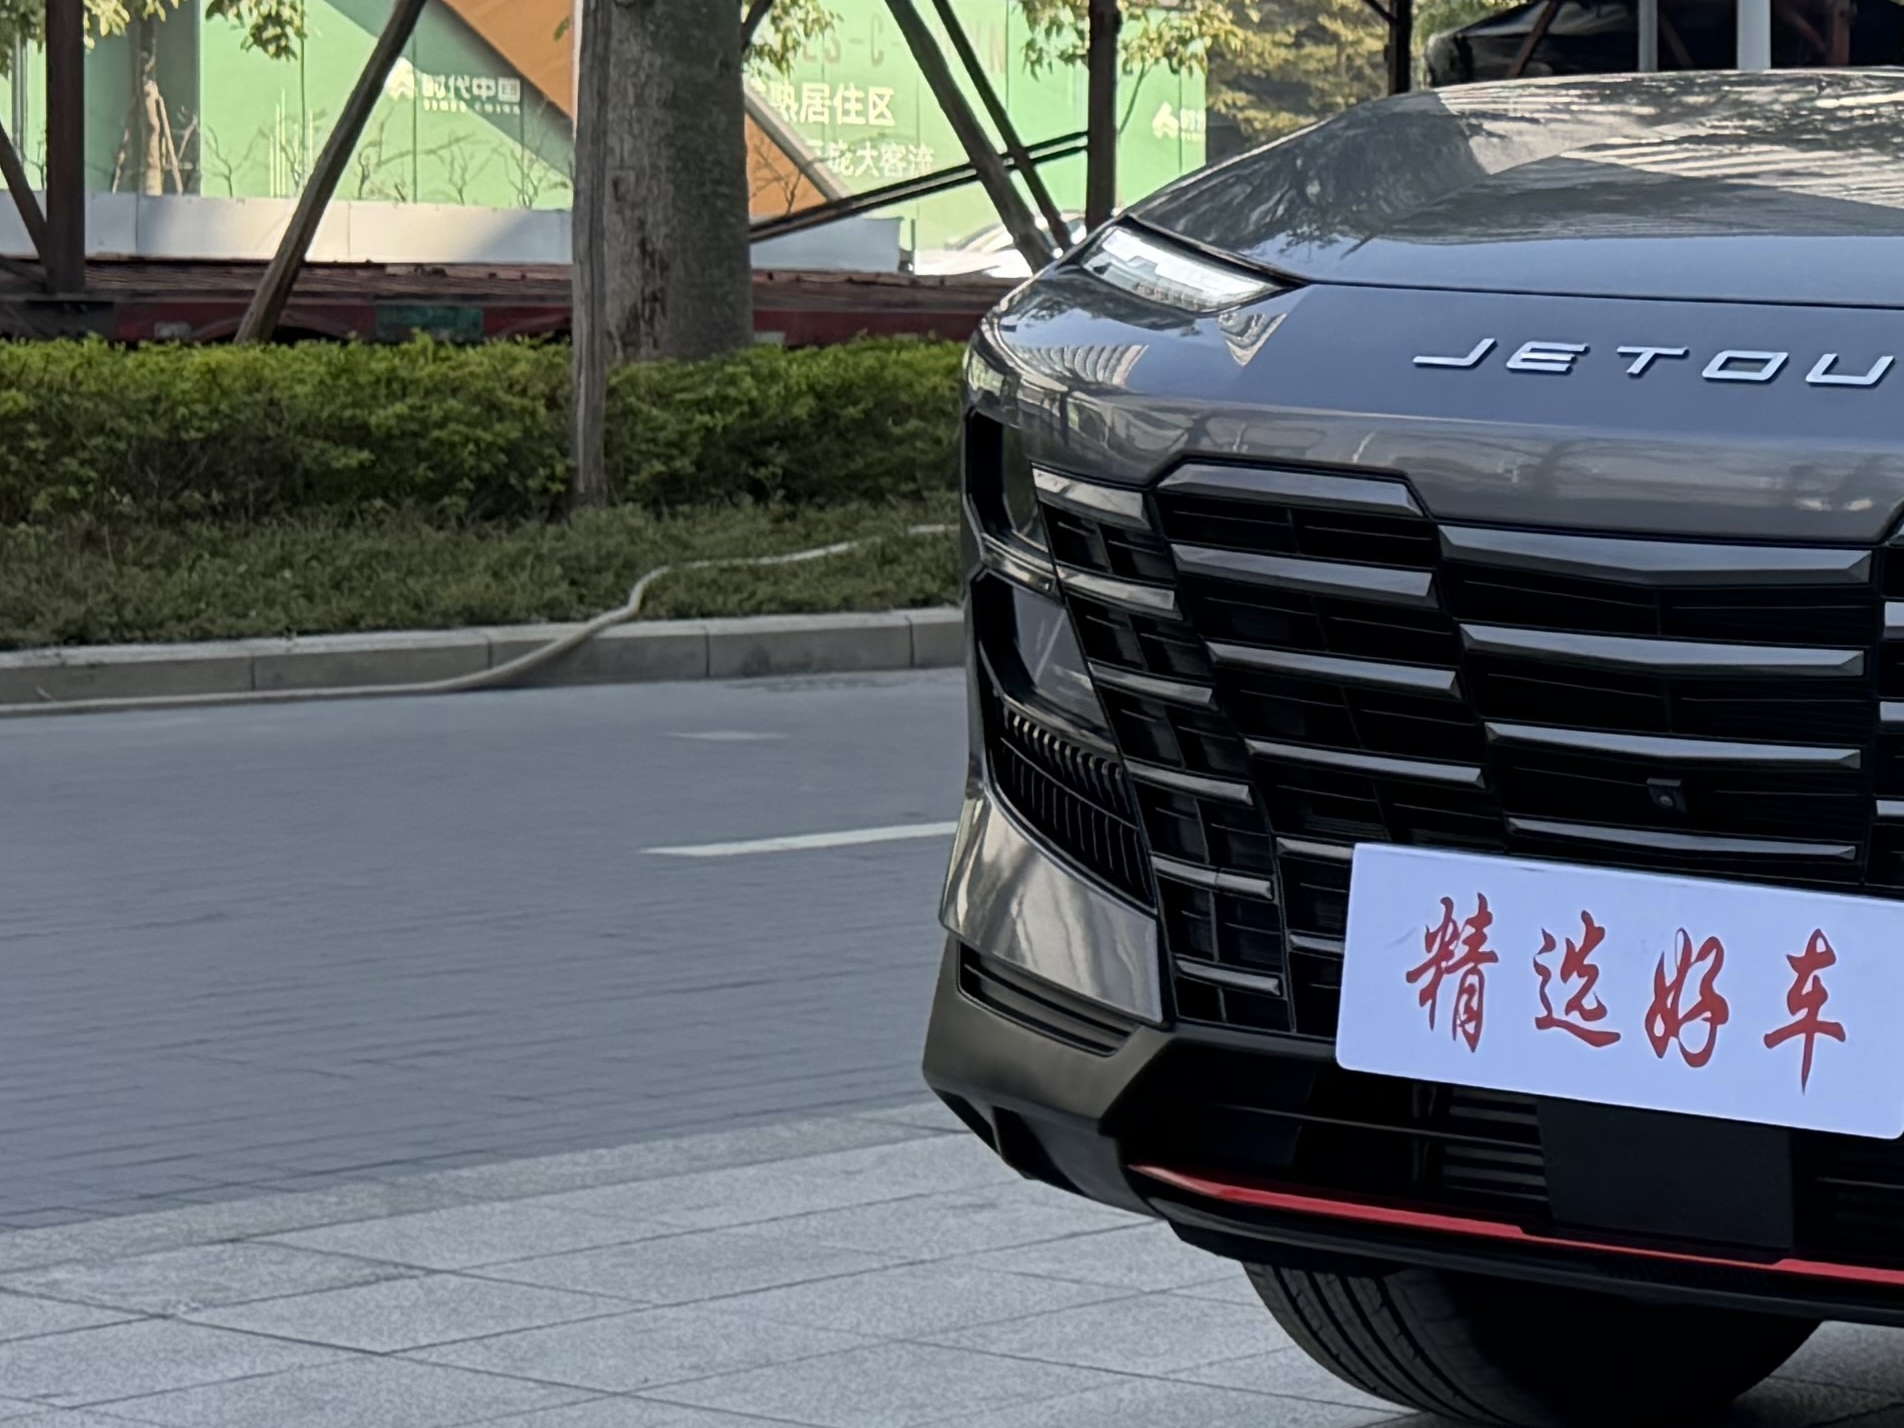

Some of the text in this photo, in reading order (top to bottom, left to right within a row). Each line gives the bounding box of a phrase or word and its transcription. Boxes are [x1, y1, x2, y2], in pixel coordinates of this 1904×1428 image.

[421, 72, 521, 103] 时代中国
[1404, 890, 1847, 1097] 精选好车
